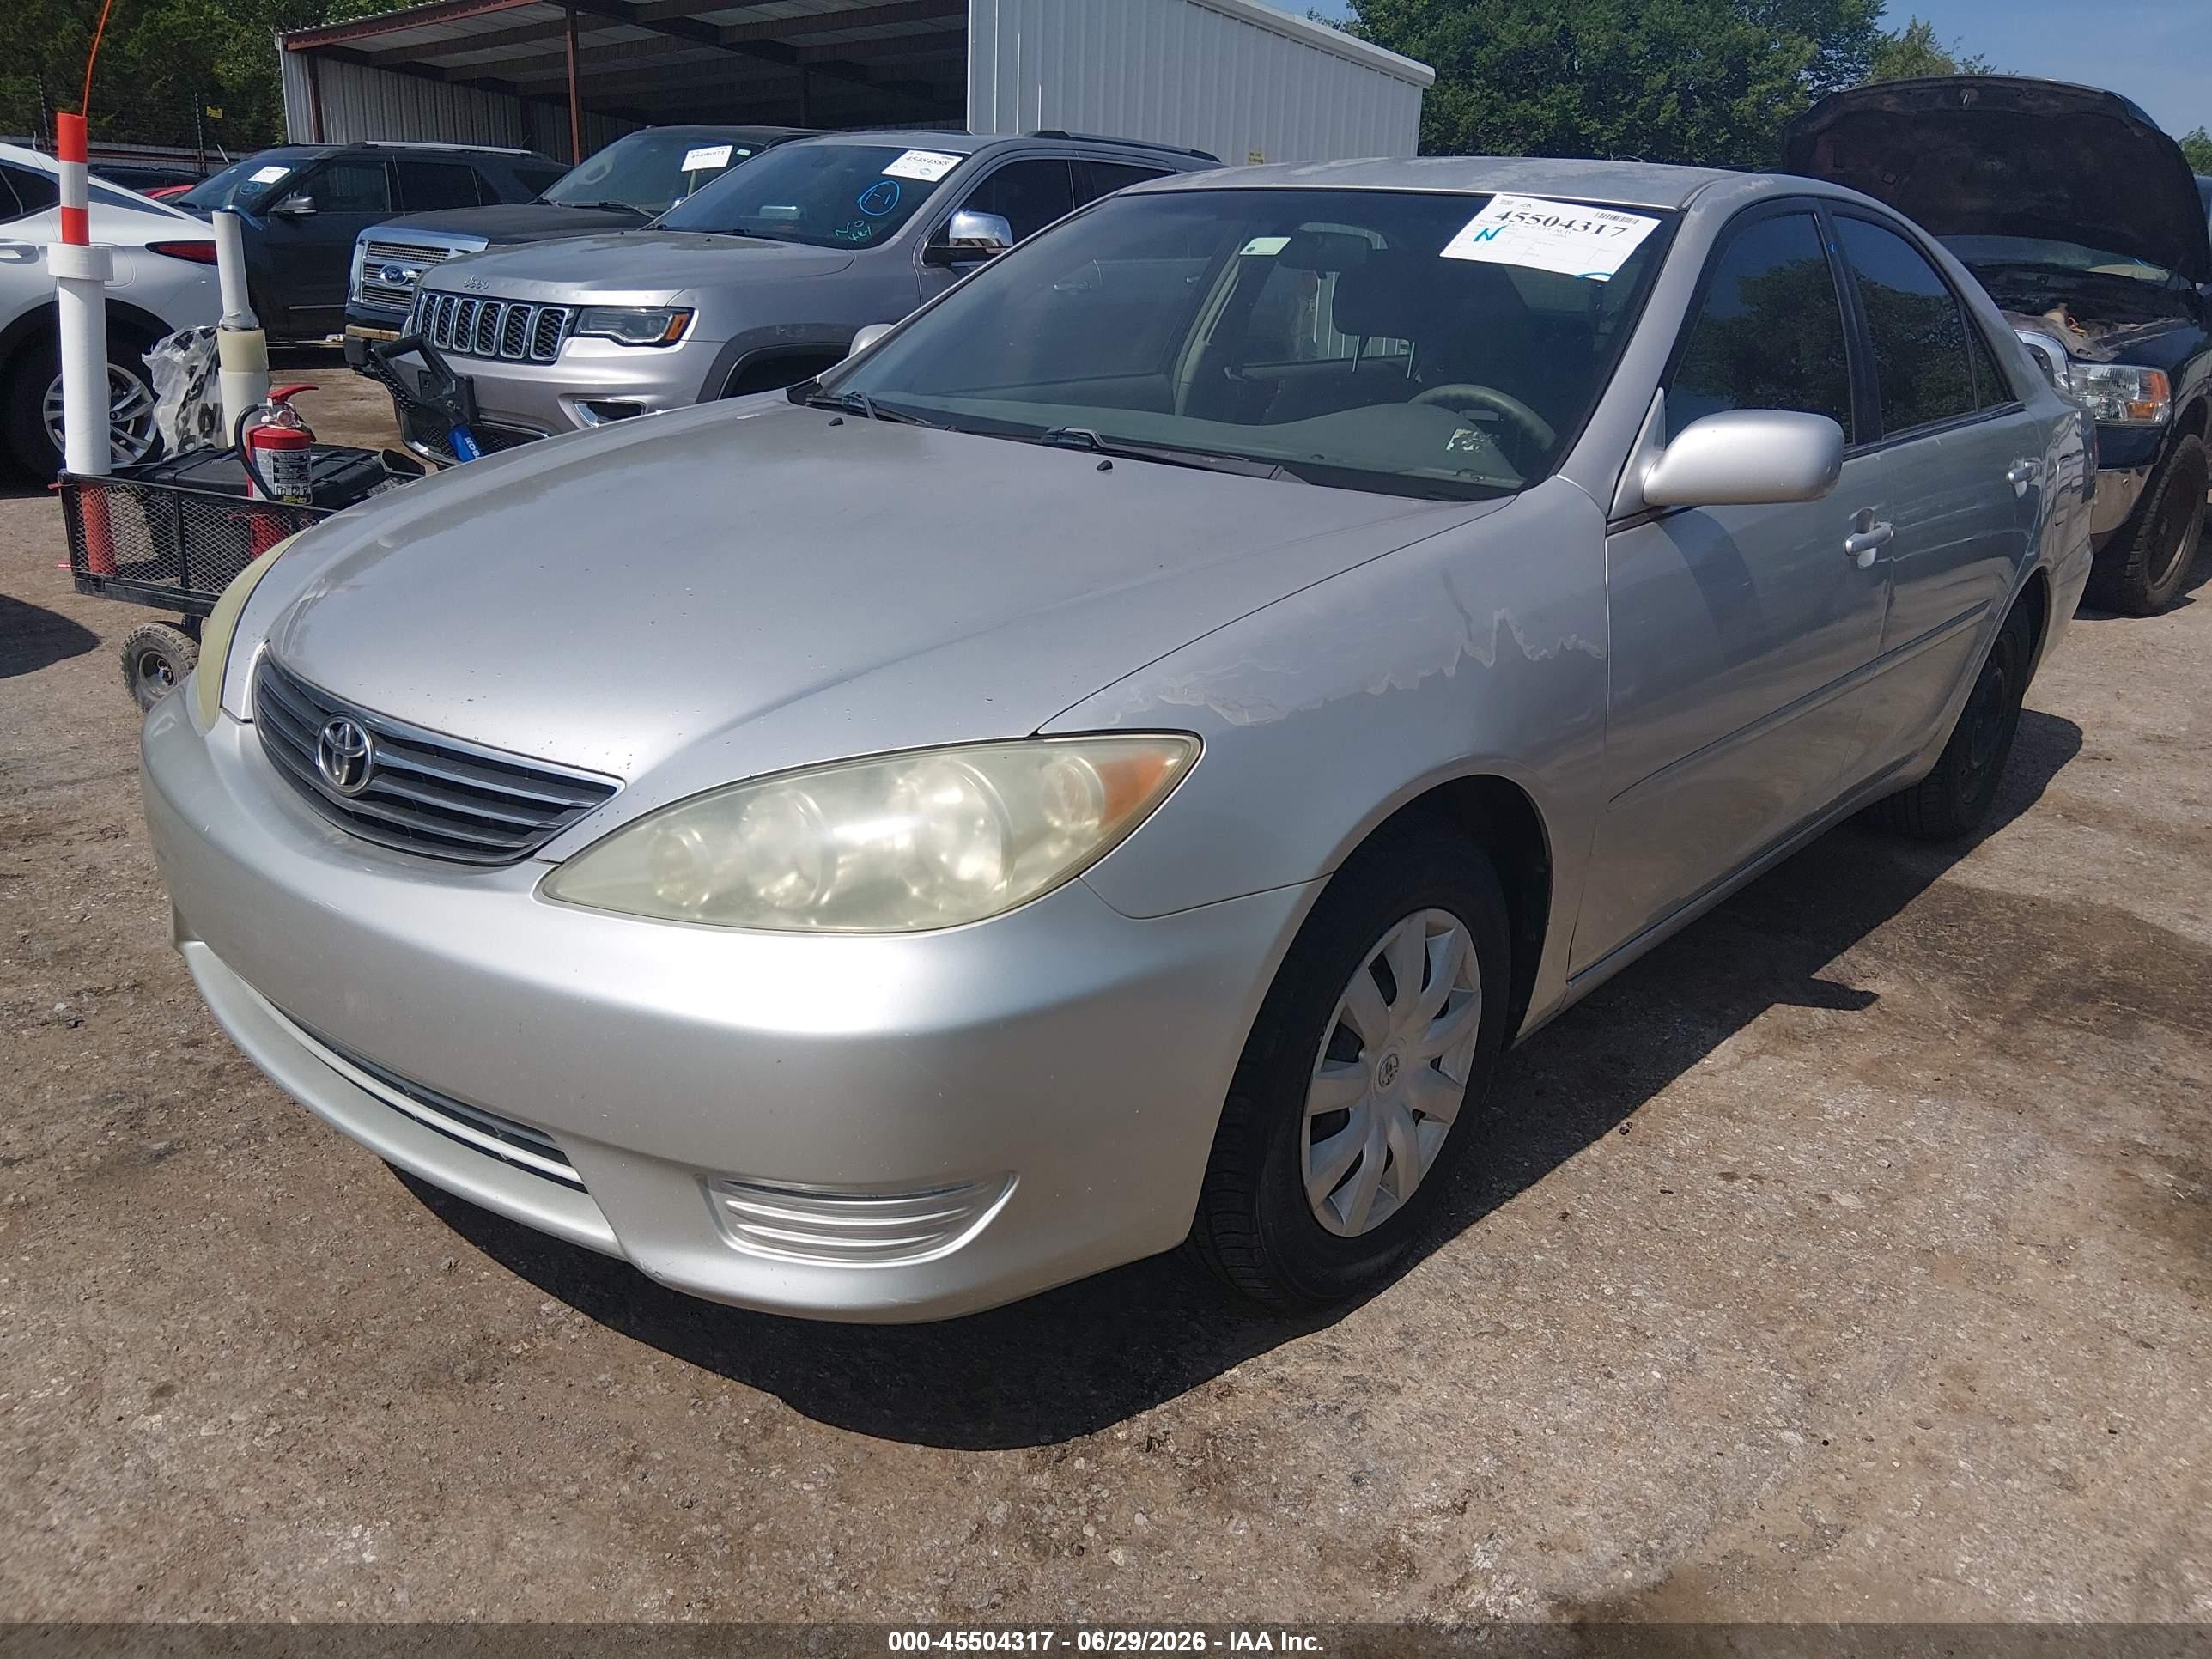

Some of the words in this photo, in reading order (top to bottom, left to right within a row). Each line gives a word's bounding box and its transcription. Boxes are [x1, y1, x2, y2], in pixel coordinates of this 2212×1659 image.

[1474, 225, 1507, 242] N
[1495, 210, 1628, 238] 45504317
[463, 275, 489, 290] Jeep
[464, 436, 482, 459] KOB
